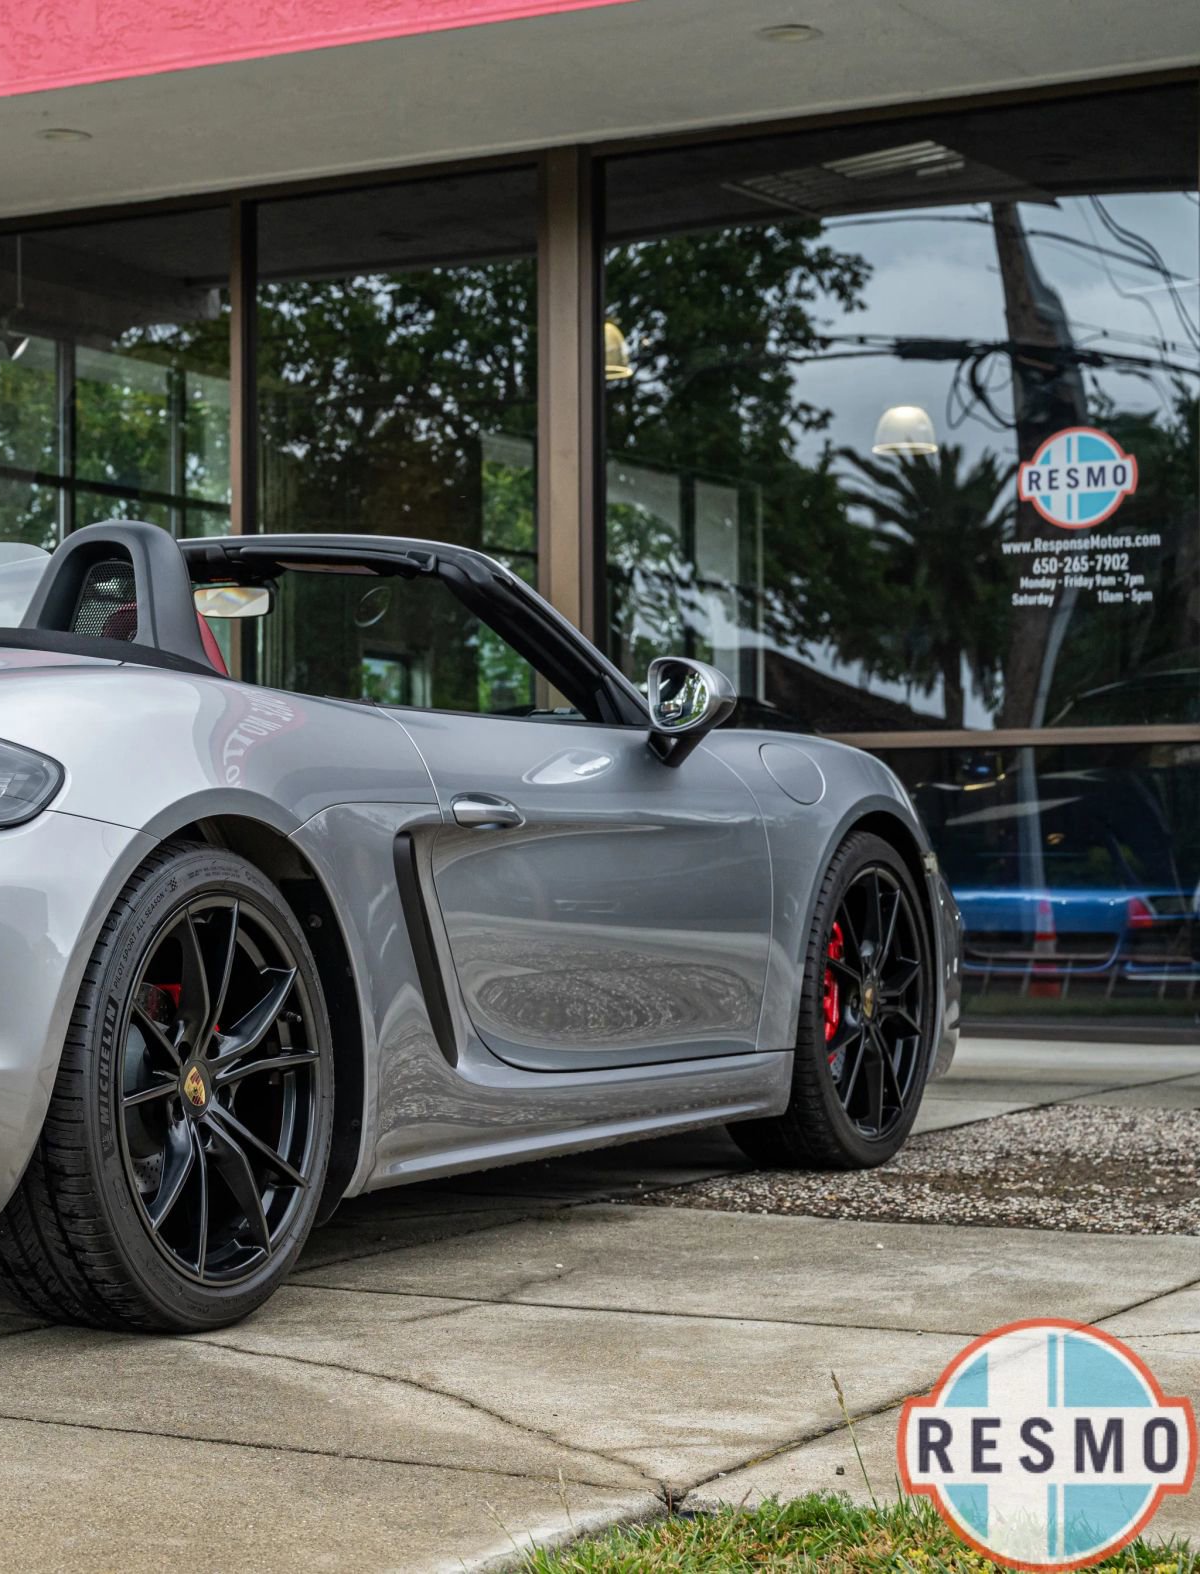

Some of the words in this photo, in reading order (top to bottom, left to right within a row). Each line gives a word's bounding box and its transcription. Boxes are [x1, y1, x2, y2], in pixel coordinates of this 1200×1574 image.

[1028, 464, 1127, 492] RESMO
[1002, 534, 1161, 555] www.ResponseMotors.com
[1032, 553, 1129, 574] 650-265-7902
[1020, 576, 1057, 591] Monday
[1063, 574, 1094, 589] Friday
[1123, 573, 1144, 588] 7pm
[1011, 592, 1055, 607] Saturday
[1097, 590, 1124, 603] 10am
[1131, 589, 1153, 604] 5pm
[113, 963, 126, 989] PILOT
[122, 933, 137, 961] SPORT
[136, 919, 147, 934] ALL
[144, 892, 166, 918] SEASON
[99, 1003, 117, 1126] MICHELIN
